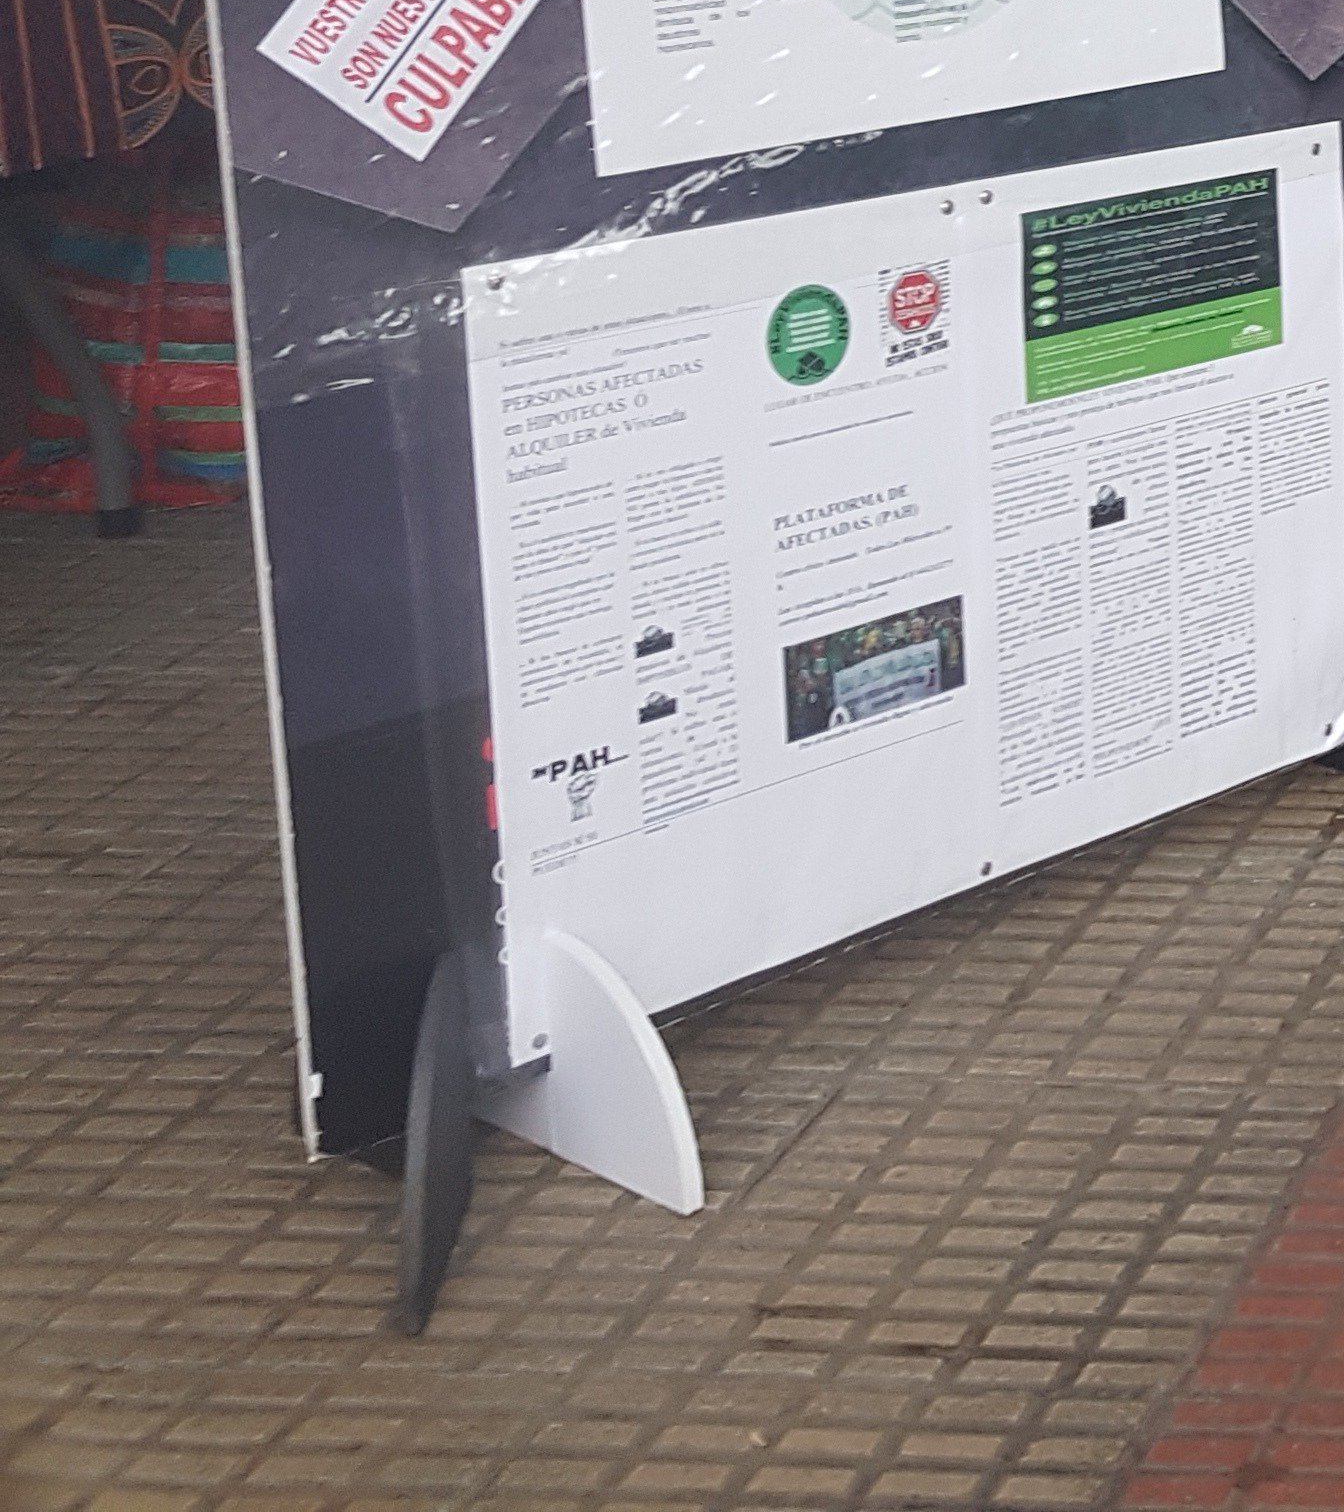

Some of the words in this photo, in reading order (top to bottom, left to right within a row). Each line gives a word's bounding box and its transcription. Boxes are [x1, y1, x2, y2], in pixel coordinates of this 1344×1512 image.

[340, 45, 389, 90] SON
[1031, 177, 1270, 232] #LeyViviendaPAH
[502, 381, 597, 414] PERSONAS
[599, 358, 704, 394] AFECTADAS
[526, 397, 628, 433] HIPOTECAS
[506, 427, 598, 459] ALQUILER
[773, 492, 885, 531] PLATAFORMA
[887, 483, 909, 501] DE
[549, 746, 611, 782] PAH
